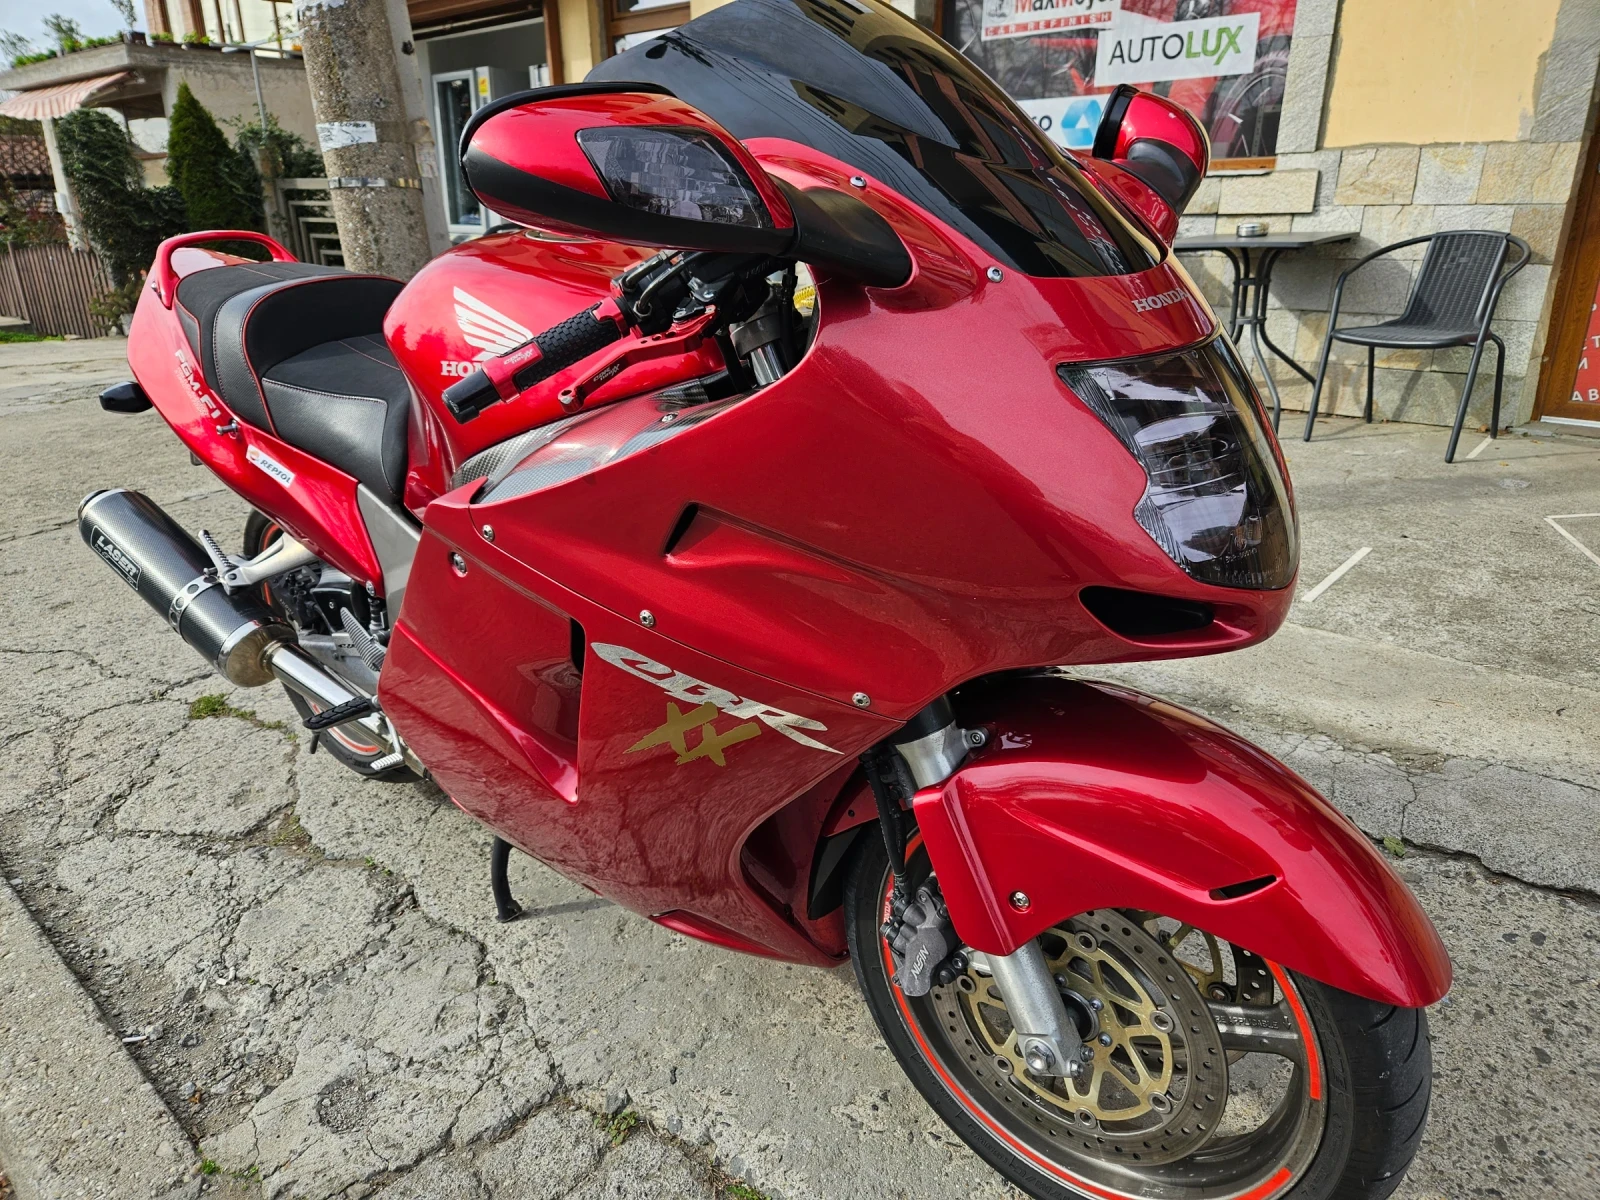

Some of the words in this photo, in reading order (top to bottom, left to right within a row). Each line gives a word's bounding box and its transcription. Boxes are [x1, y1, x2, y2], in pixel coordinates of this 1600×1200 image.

[1028, 13, 1111, 31] REFINISH
[1108, 25, 1244, 66] AUTOLUX
[1132, 287, 1190, 313] HONDA
[260, 458, 292, 484] REPSOL
[96, 535, 137, 577] LASER
[591, 642, 845, 755] CBR
[623, 701, 762, 766] XX
